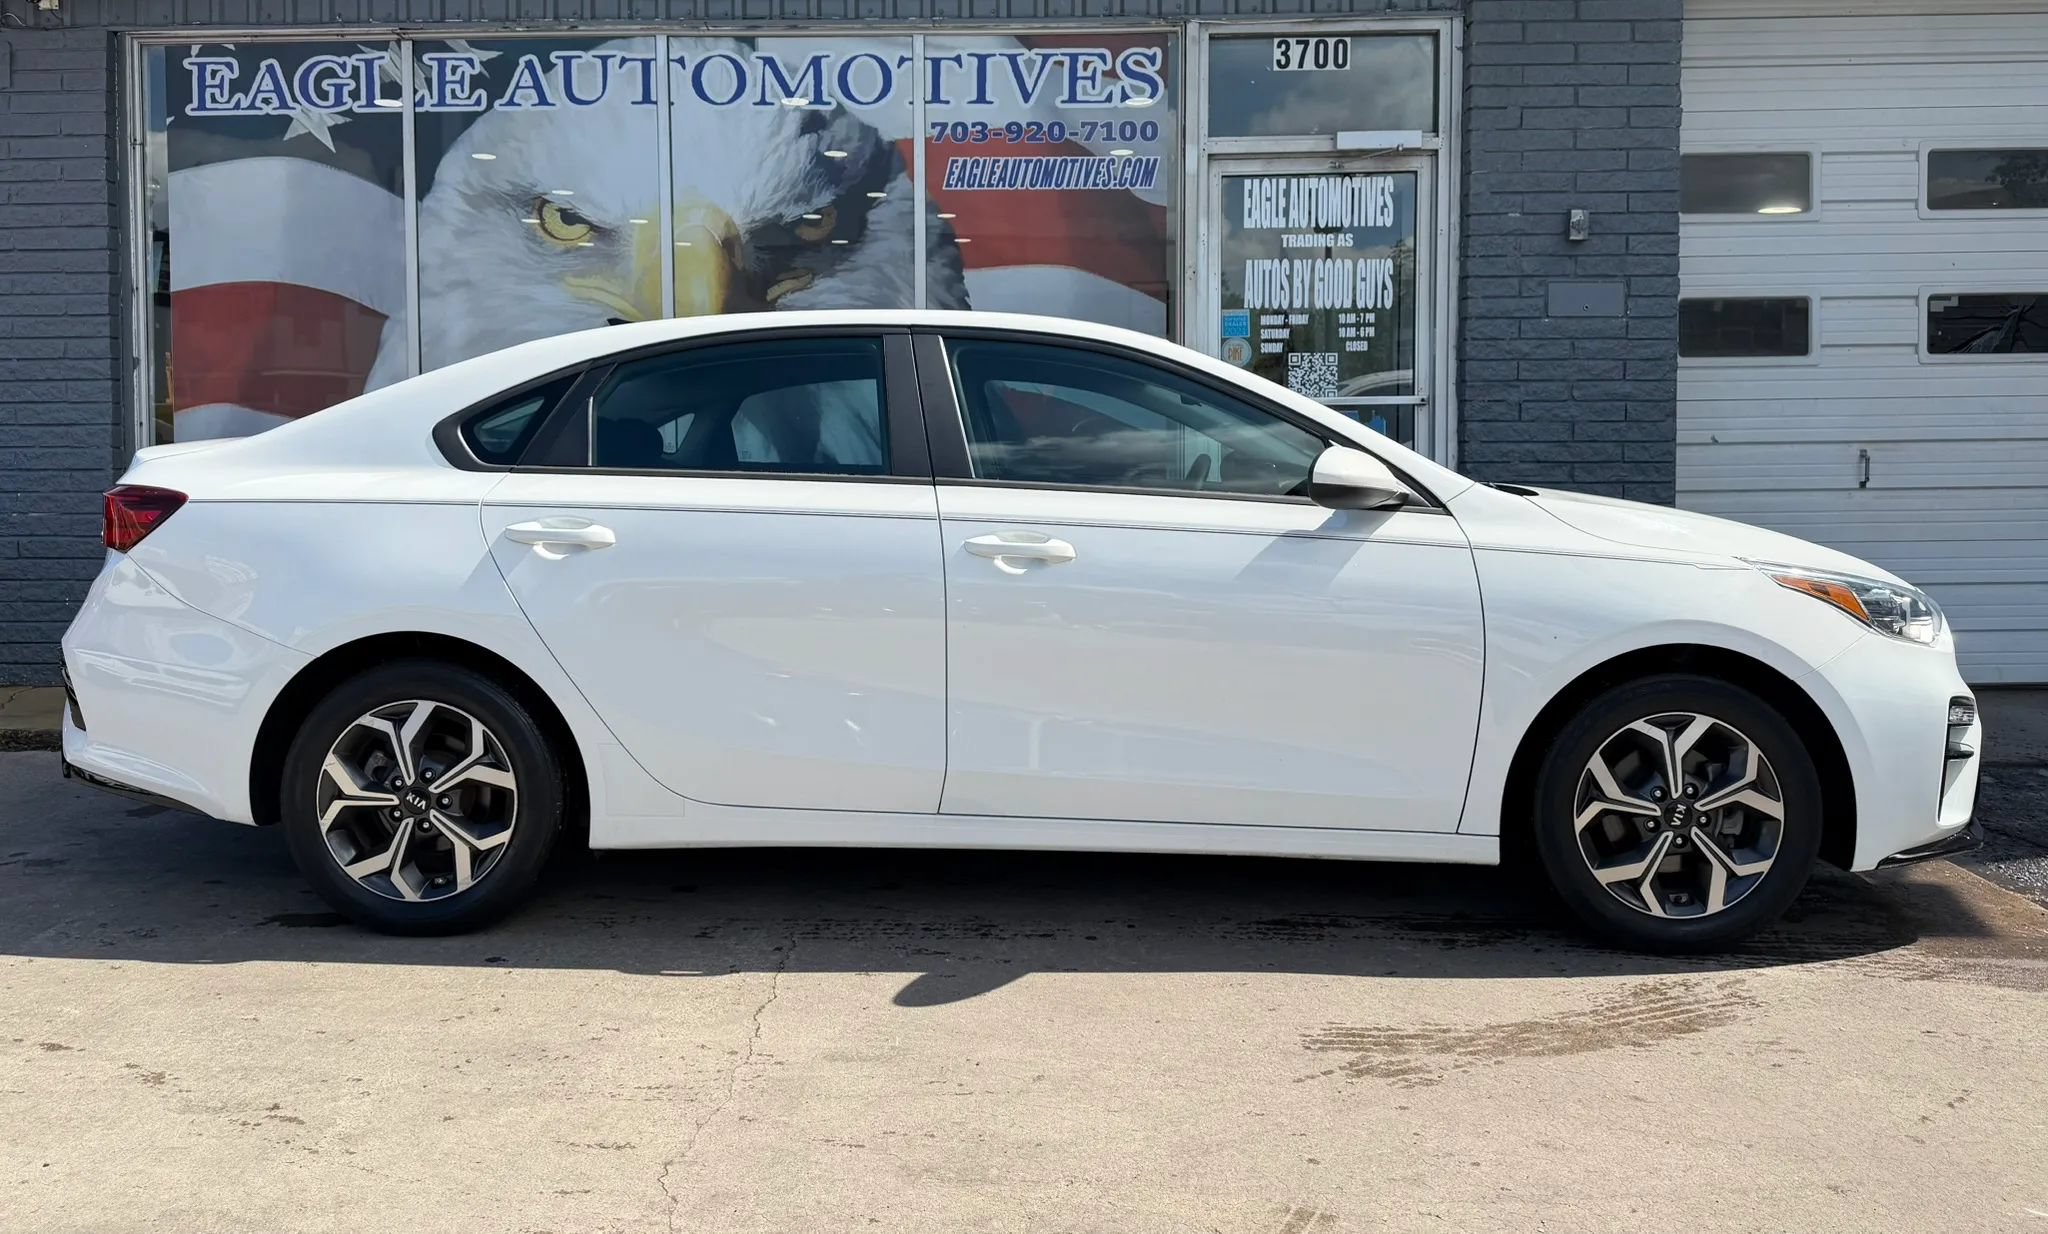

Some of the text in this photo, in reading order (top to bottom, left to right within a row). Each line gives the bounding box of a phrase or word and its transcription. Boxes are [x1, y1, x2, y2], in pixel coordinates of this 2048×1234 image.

[1275, 38, 1349, 70] 3700
[183, 48, 1168, 115] EAGLE AUTOMOTIVES
[930, 120, 1159, 144] 703-920-7100
[943, 156, 1160, 190] EAGLEAUTOMOTIVES.COM
[1243, 176, 1395, 229] EAGLE AUTOMOTIVES
[1281, 233, 1354, 248] TRADING AS
[1243, 257, 1394, 310] AUTOS BY GOOD GUYS
[1260, 314, 1285, 326] MONDAY
[1289, 313, 1309, 325] FRIDAY
[1338, 313, 1346, 324] 10
[1346, 313, 1356, 324] AM
[1360, 312, 1364, 324] 7
[1365, 312, 1376, 324] PM
[1260, 328, 1290, 340] SATURDAY
[1338, 327, 1346, 338] 10
[1346, 327, 1356, 338] AM
[1365, 326, 1375, 337] PM
[1260, 342, 1283, 354] SUNDAY
[1345, 341, 1368, 352] CLOSED
[406, 792, 426, 810] KIA
[1670, 804, 1687, 825] KIA
